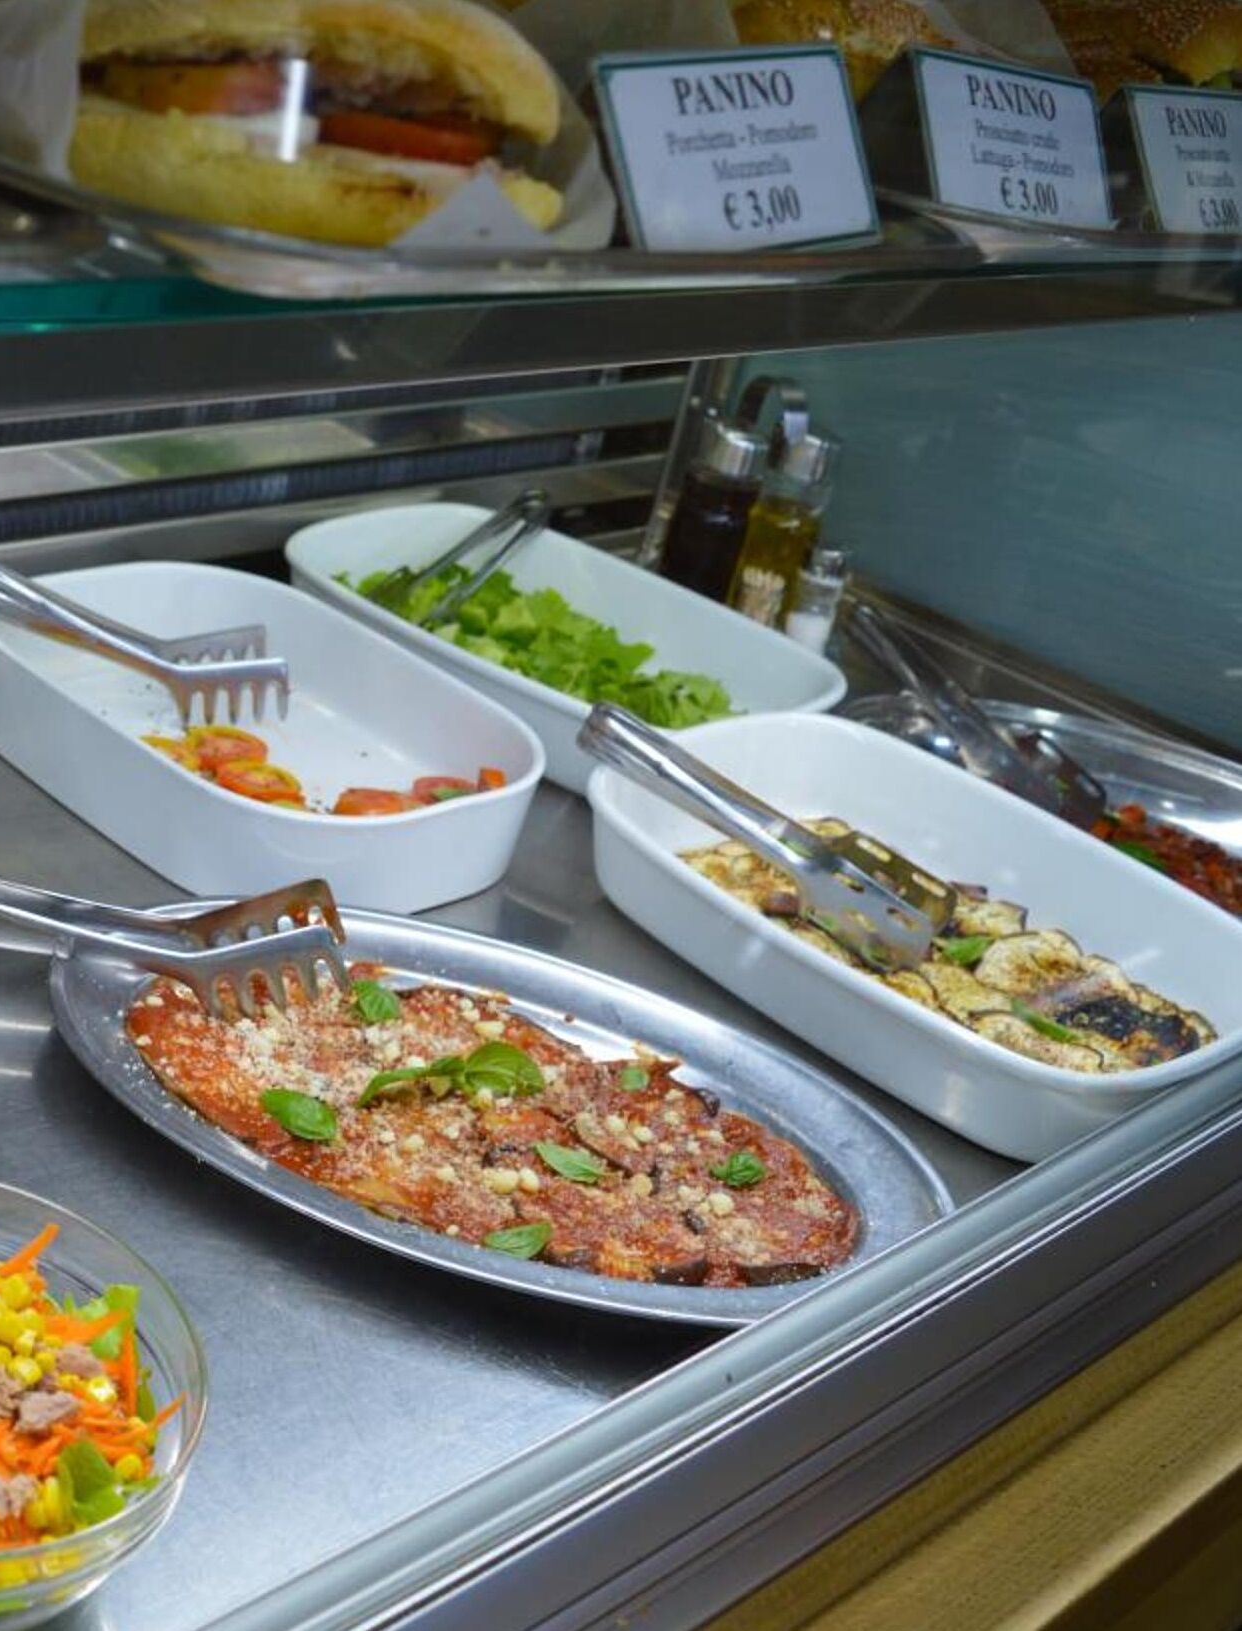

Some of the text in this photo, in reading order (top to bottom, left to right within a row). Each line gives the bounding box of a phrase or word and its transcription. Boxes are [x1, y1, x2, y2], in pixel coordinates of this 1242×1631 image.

[672, 69, 794, 116] PANINO
[964, 74, 1057, 121] PANINO
[1164, 106, 1227, 138] PANINO
[723, 185, 801, 232] € 3,00
[1000, 176, 1059, 216] € 3,00
